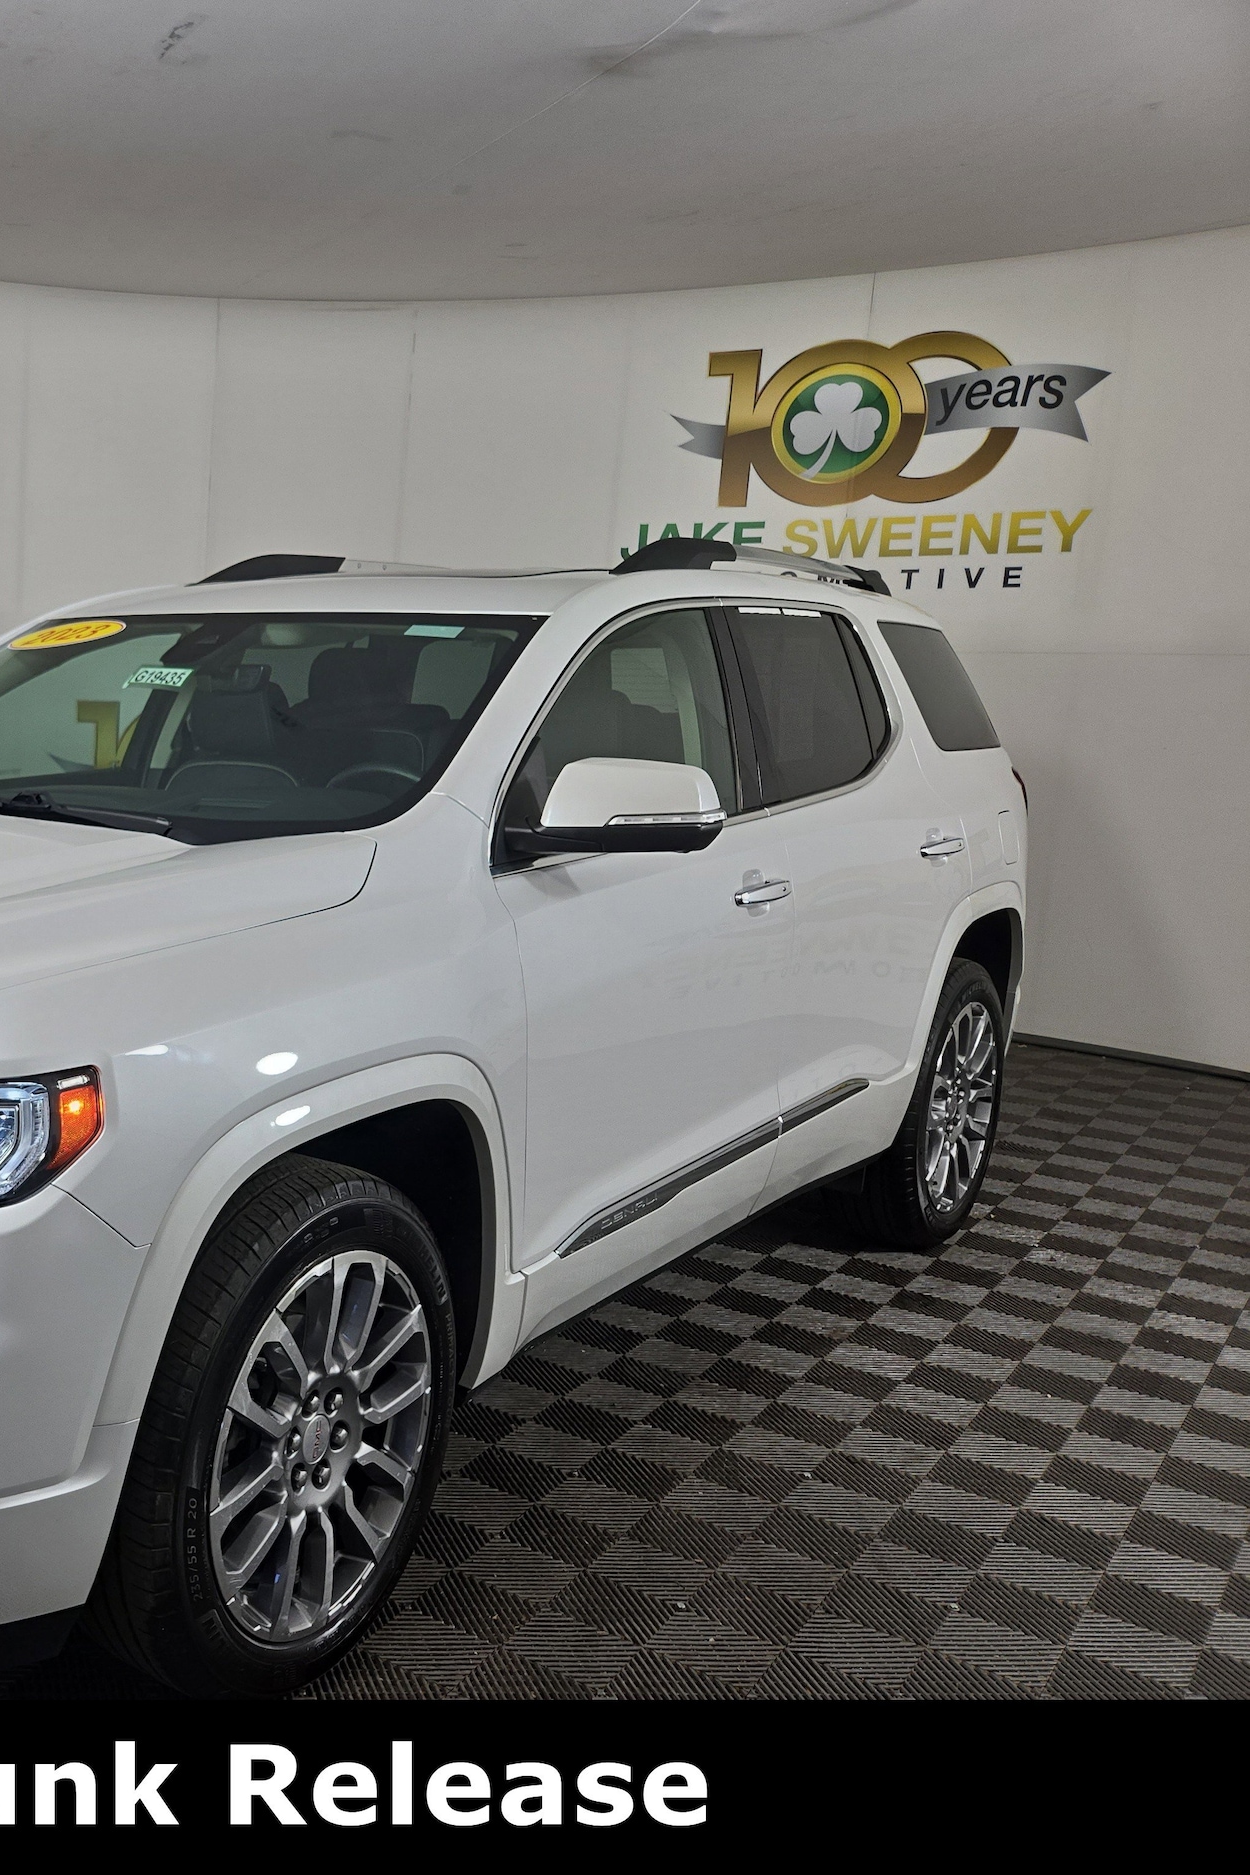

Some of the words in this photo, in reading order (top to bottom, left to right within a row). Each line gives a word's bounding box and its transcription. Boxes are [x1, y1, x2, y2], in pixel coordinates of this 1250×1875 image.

[935, 369, 1068, 426] years
[782, 510, 1093, 560] SWEENEY
[20, 624, 111, 647] 2023
[134, 669, 187, 686] G19435
[311, 1420, 323, 1459] GMC
[186, 1497, 199, 1520] 20
[186, 1527, 197, 1539] R
[186, 1545, 204, 1602] 235/55
